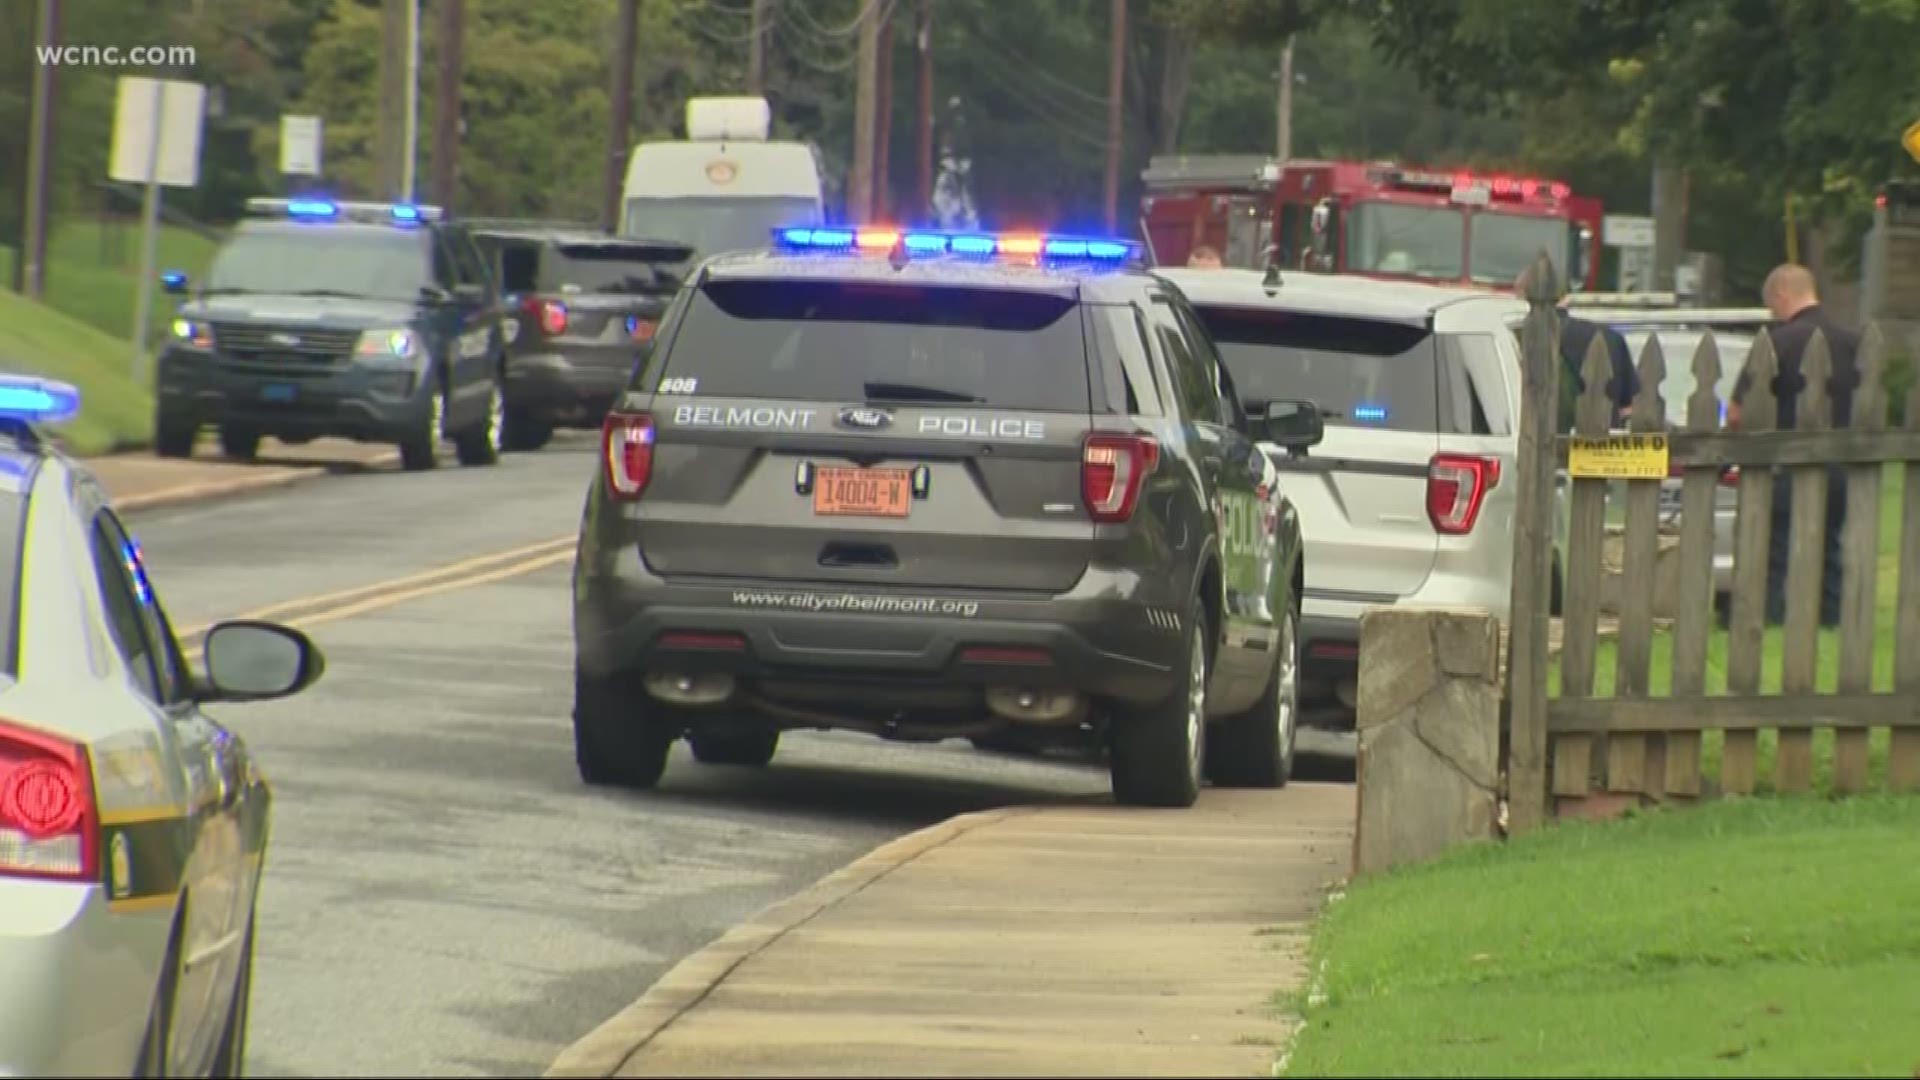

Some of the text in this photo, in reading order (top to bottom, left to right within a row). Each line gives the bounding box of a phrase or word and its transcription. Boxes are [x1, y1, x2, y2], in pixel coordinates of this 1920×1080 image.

[674, 405, 817, 428] BELMONT
[919, 416, 1045, 438] POLICE
[732, 589, 979, 617] www.cityofbelmont.org
